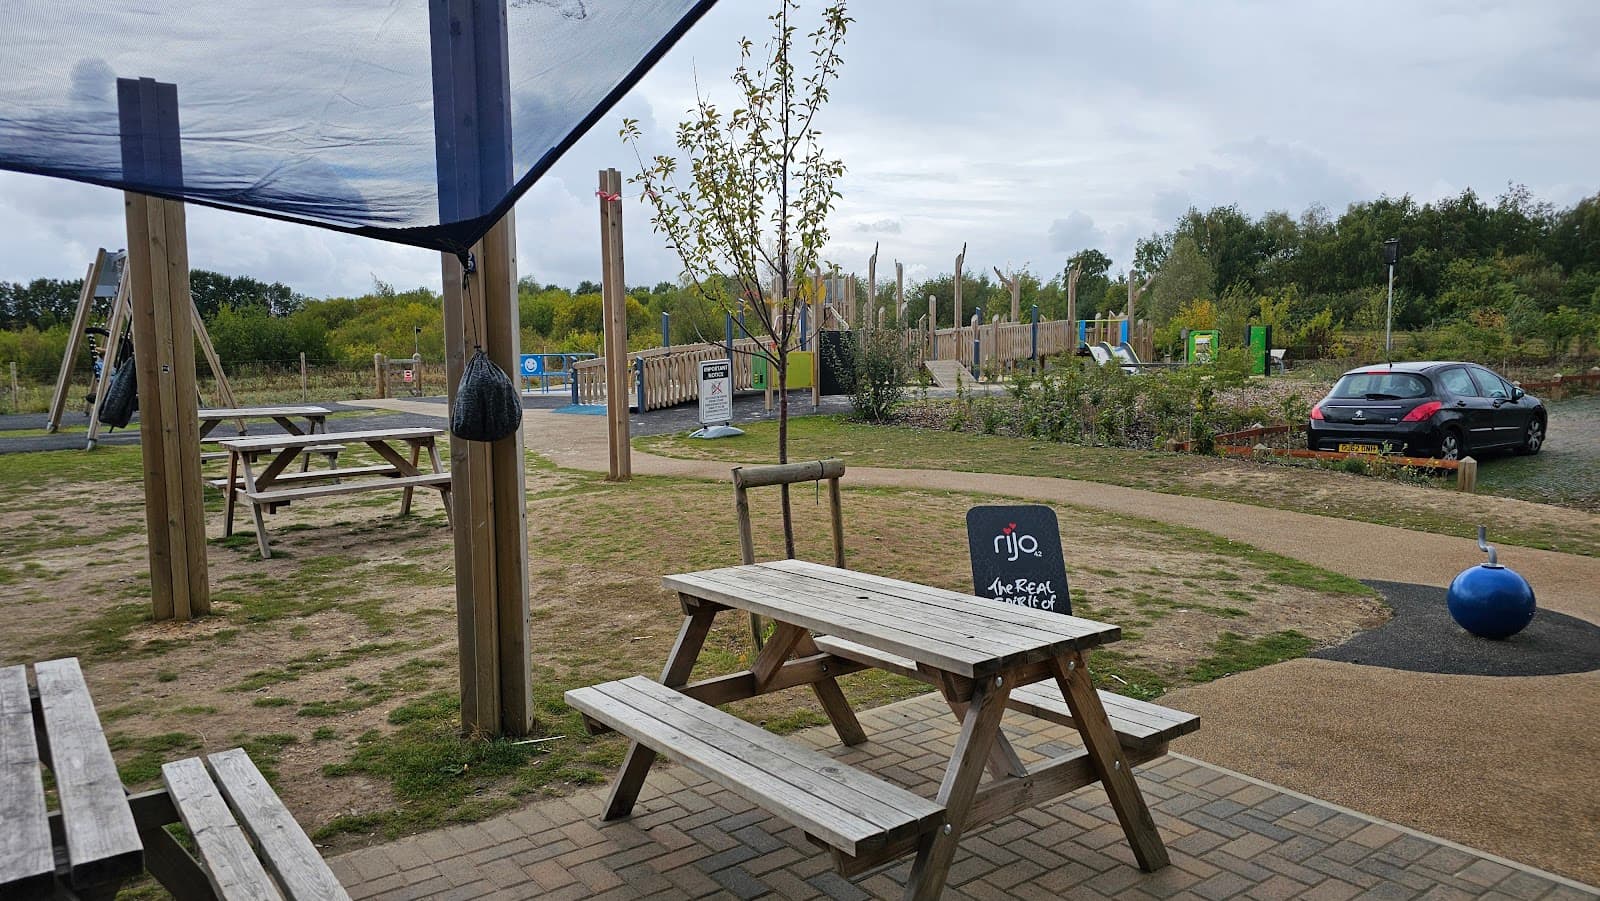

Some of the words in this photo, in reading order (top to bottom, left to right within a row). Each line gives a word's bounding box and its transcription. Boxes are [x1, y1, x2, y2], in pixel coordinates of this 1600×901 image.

[994, 523, 1038, 561] rijo
[988, 577, 1013, 596] The
[1015, 579, 1055, 596] REAL
[1041, 595, 1056, 611] of
